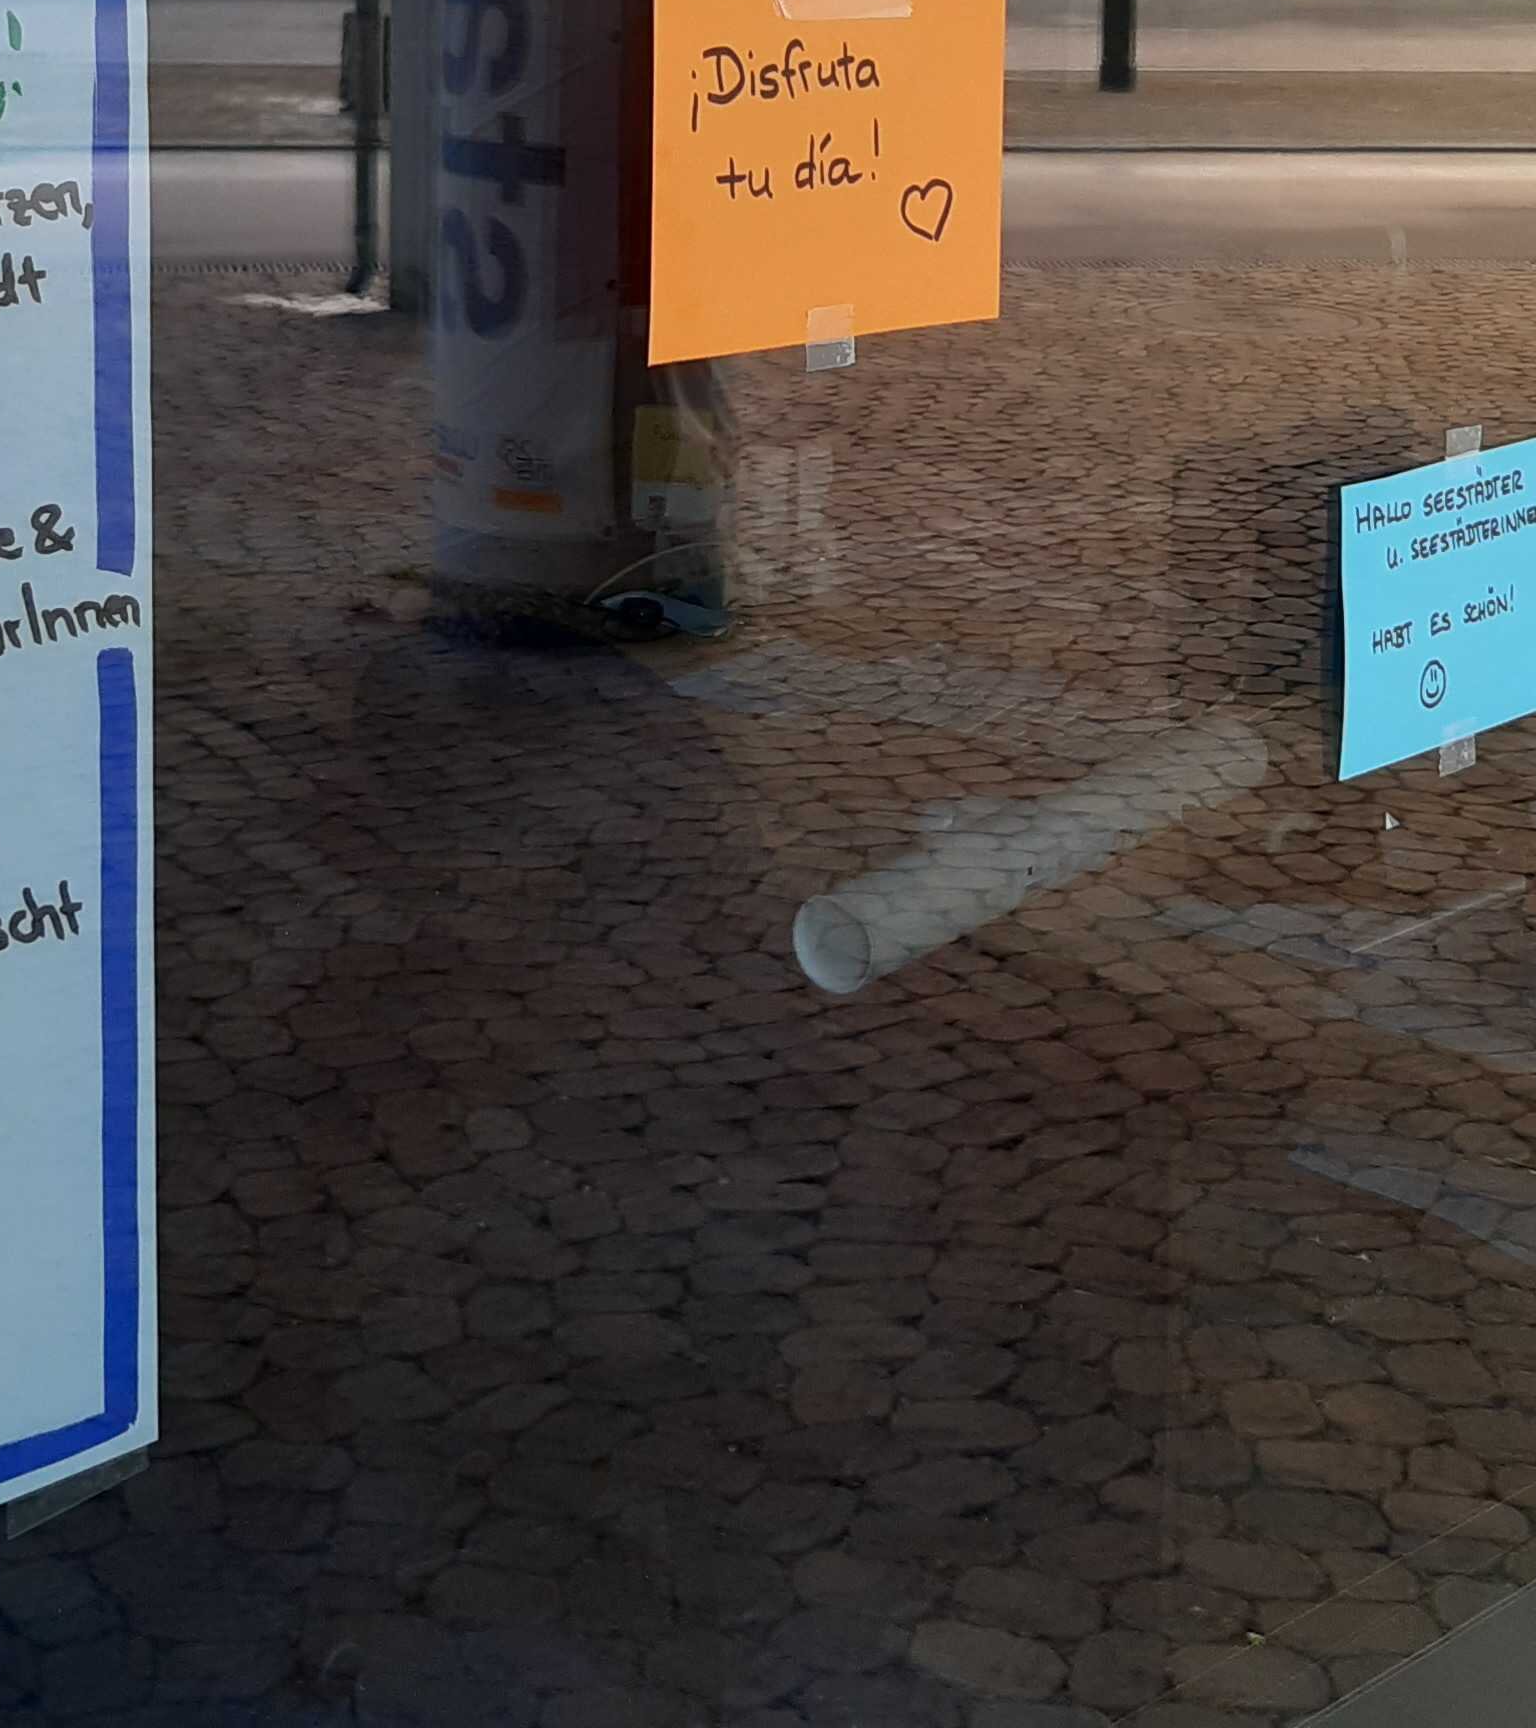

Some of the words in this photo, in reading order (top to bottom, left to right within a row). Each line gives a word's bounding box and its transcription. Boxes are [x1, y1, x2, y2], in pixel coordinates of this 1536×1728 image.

[689, 37, 881, 134] ¡Disfruta
[715, 156, 774, 200] tu
[793, 116, 880, 191] día!
[30, 503, 75, 552] &
[1354, 501, 1413, 534] HALLO
[1421, 465, 1525, 518] SEESTÄDTER
[1370, 621, 1414, 654] HABT
[1429, 611, 1453, 639] ES
[1462, 583, 1516, 626] SCHÖN!
